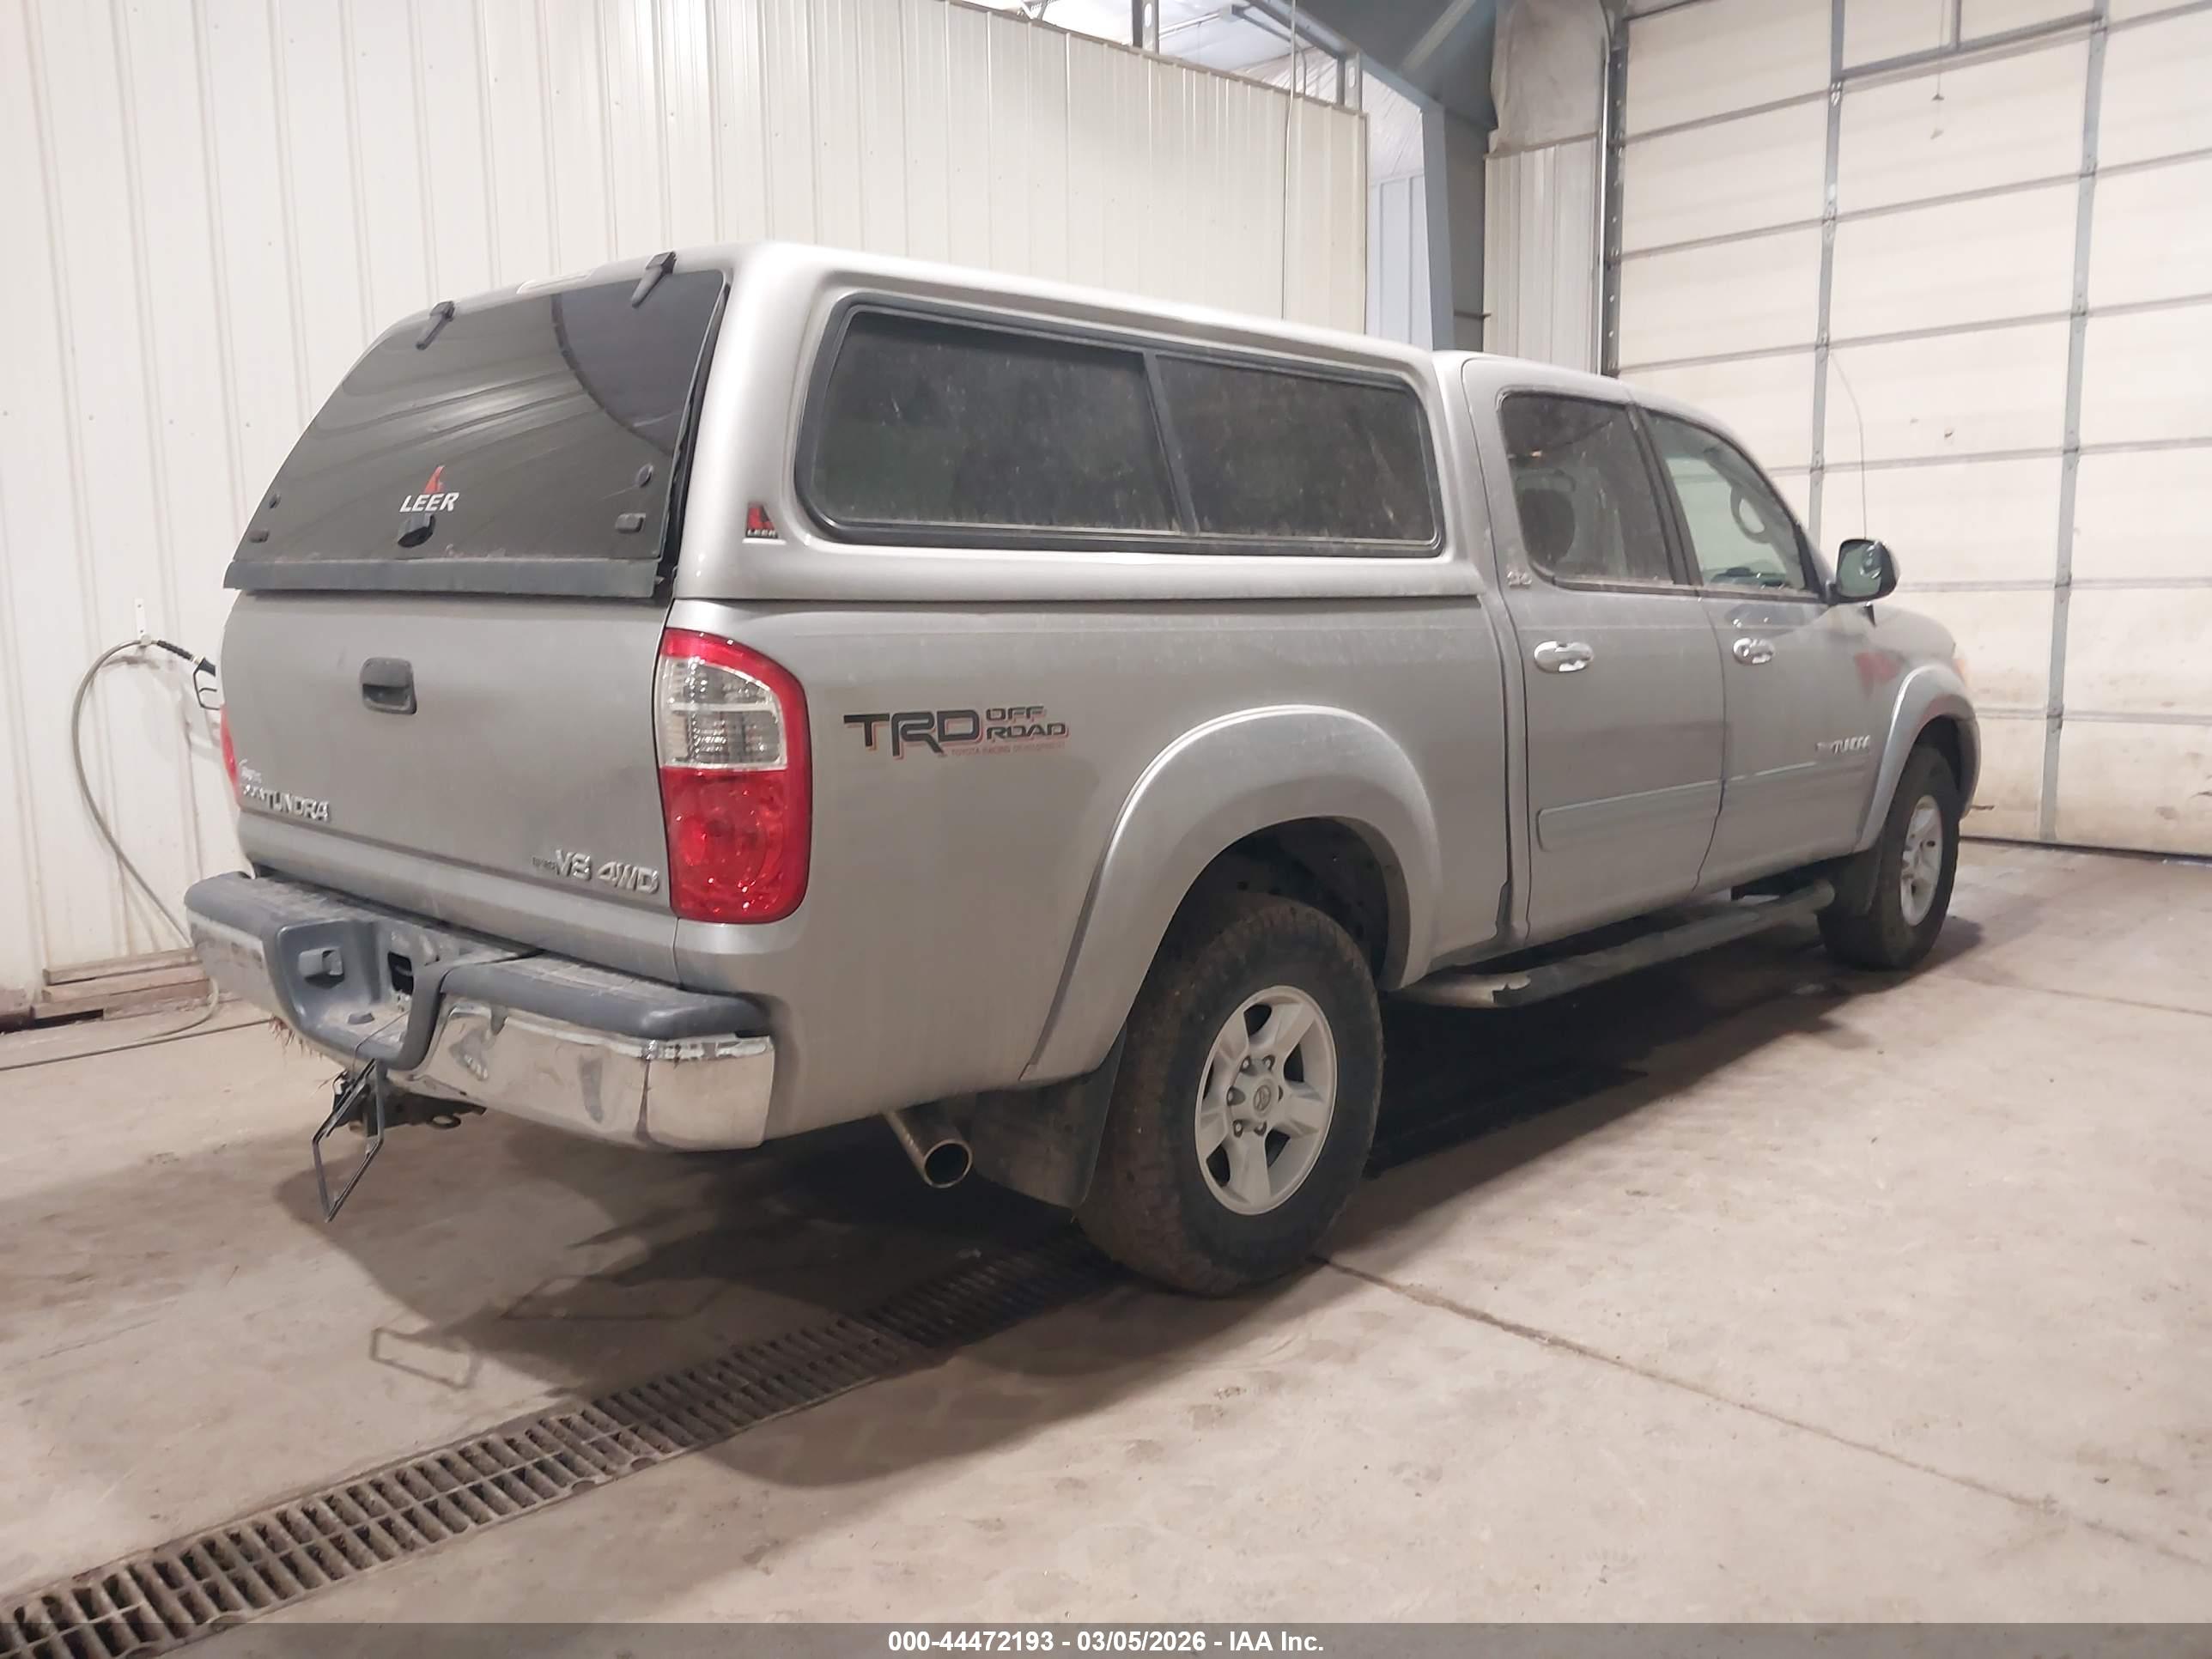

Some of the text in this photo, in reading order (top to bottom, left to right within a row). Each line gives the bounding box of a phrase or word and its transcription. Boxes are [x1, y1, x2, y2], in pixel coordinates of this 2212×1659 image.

[399, 492, 460, 513] LEER
[843, 706, 1047, 759] TRD OFF
[987, 722, 1068, 742] ROAD
[264, 789, 331, 822] TUNDRA
[556, 849, 592, 880] V8
[598, 861, 659, 893] 4WD
